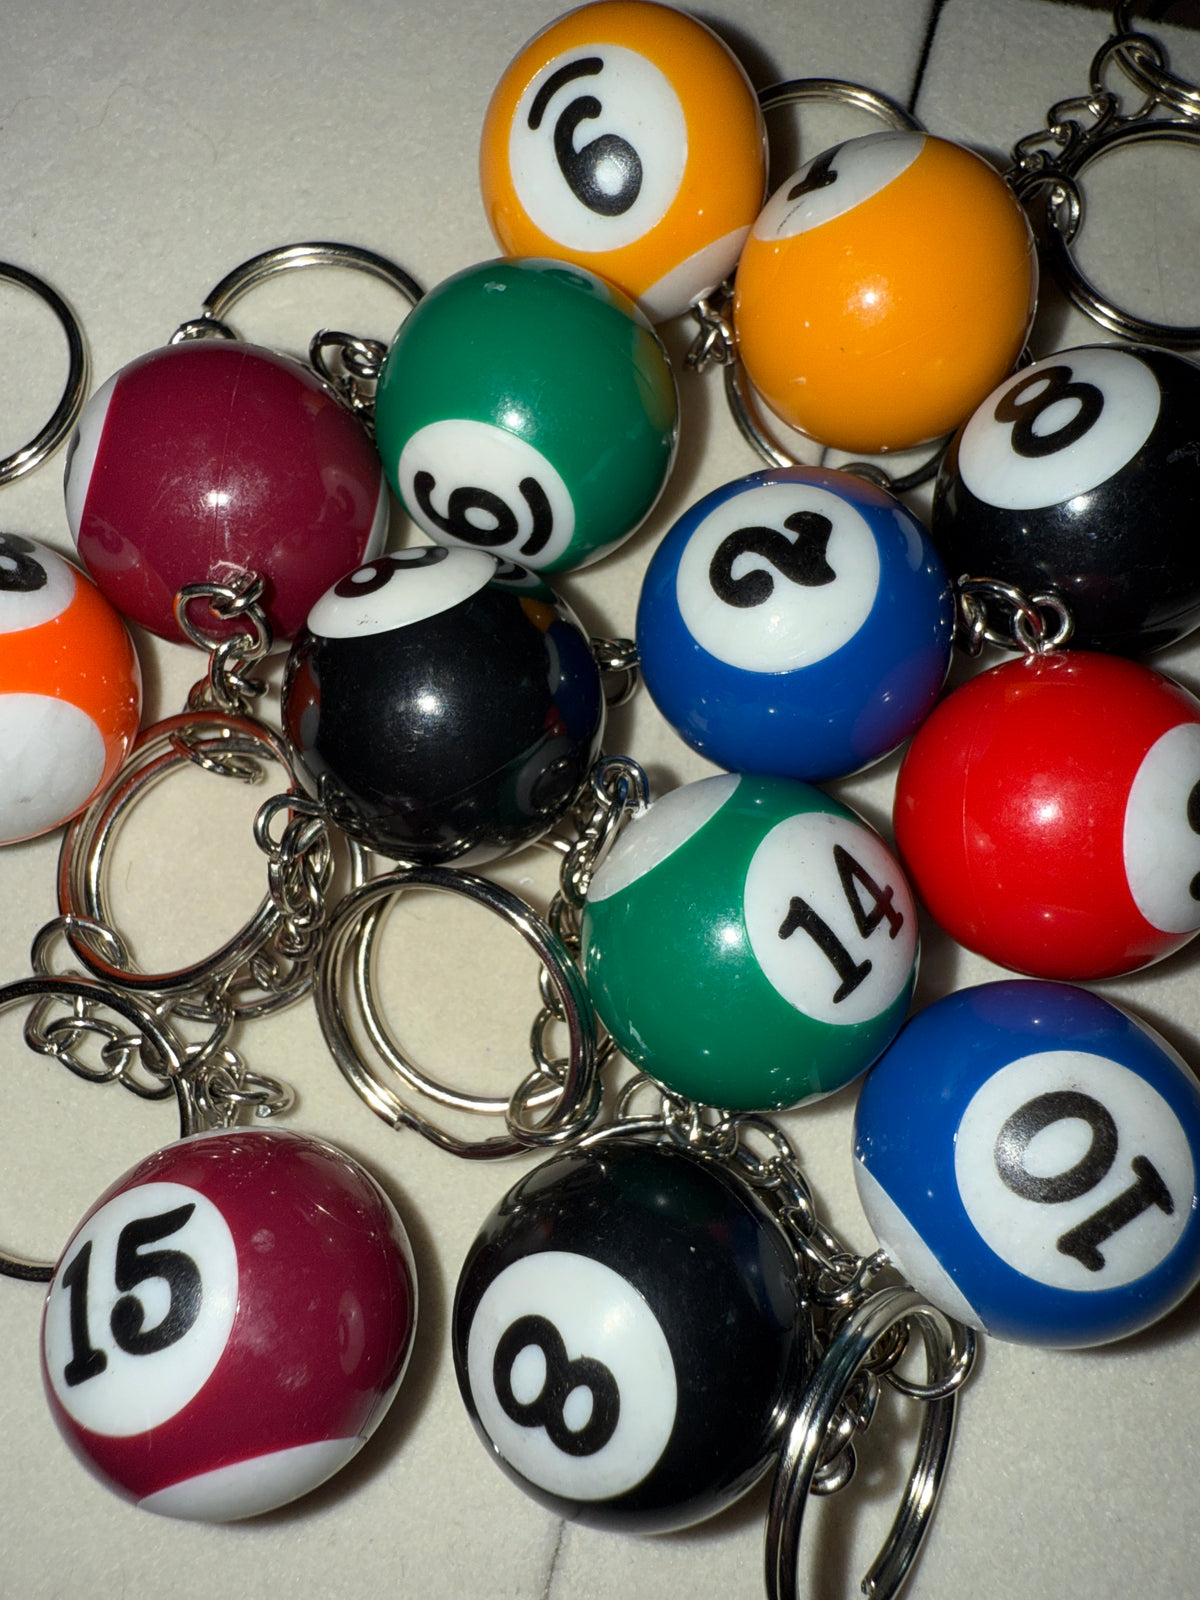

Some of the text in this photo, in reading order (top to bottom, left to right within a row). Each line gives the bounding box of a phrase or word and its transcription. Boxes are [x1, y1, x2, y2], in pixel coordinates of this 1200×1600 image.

[994, 365, 1105, 458] 8
[413, 470, 519, 547] 6
[709, 510, 837, 608] 2
[334, 546, 449, 598] 8
[778, 843, 904, 1004] 14
[993, 1090, 1175, 1272] 10
[62, 1203, 203, 1387] 15
[493, 1314, 621, 1457] 8
